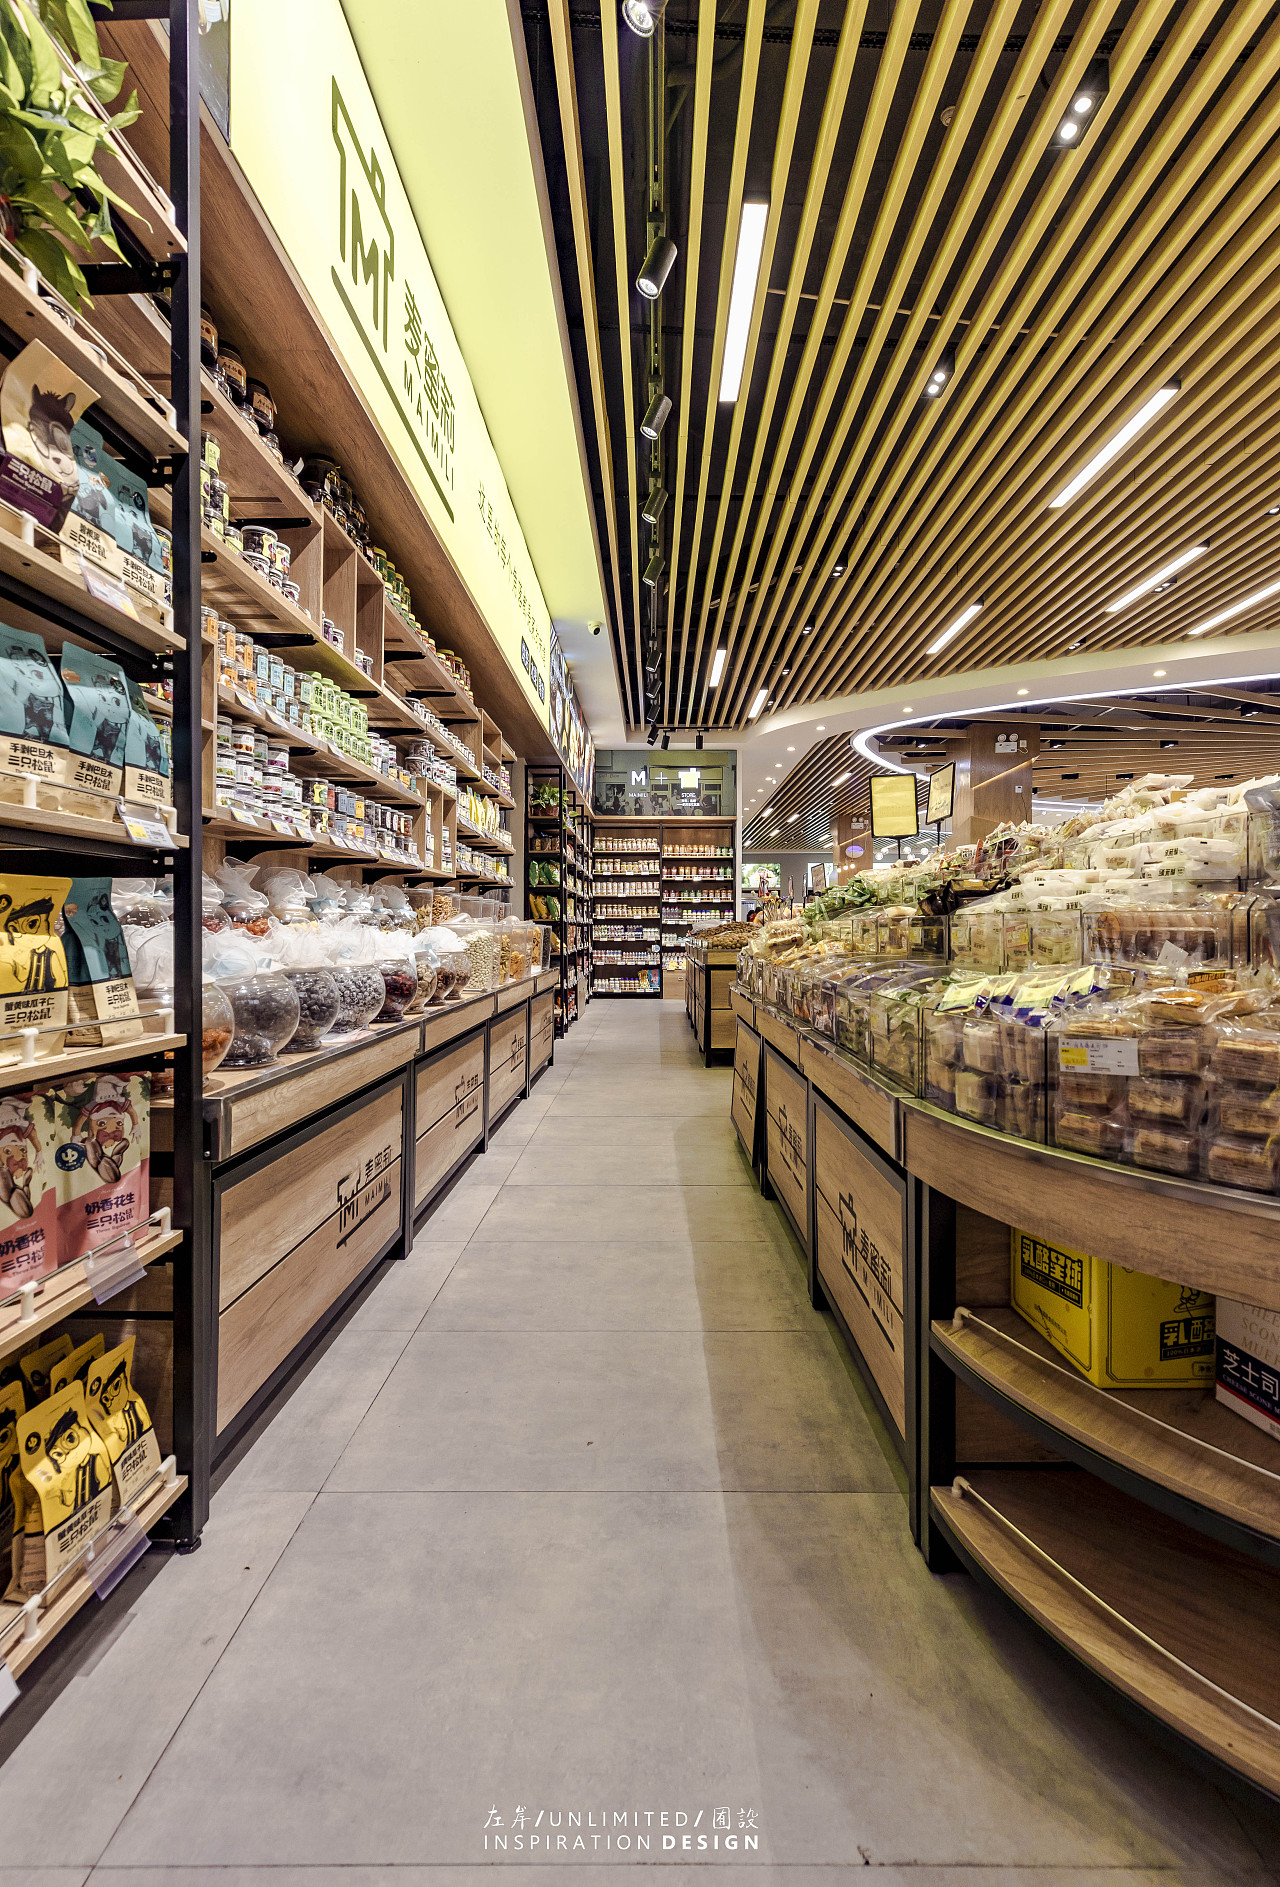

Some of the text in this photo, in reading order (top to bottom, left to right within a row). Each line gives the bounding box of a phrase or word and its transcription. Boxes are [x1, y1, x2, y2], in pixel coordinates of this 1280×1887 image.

[404, 360, 454, 491] MAIMILI
[7, 458, 52, 493] 三只松鼠
[69, 529, 106, 559] 三只松鼠
[123, 556, 155, 582] 手剥巴旦木
[122, 567, 155, 593] 三只松鼠
[10, 742, 54, 760] 手剥巴旦木
[8, 755, 54, 773] 三只松鼠
[78, 760, 113, 779] 手剥巴旦木
[74, 772, 110, 791] 三只松鼠
[137, 783, 165, 799] 三只松鼠
[138, 773, 164, 788] 手剥巴旦木
[4, 997, 55, 1012] 蟹黄味瓜子仁
[107, 992, 131, 1006] 三只松鼠
[4, 1007, 52, 1024] 三只松鼠
[85, 1192, 135, 1216] 奶香花生
[87, 1208, 134, 1230] 三只松鼠
[1022, 1238, 1082, 1291] 乳酪星球
[862, 1266, 894, 1329] MIMILI
[1222, 1374, 1248, 1394] CHEESE
[60, 1511, 99, 1552] 三只松鼠
